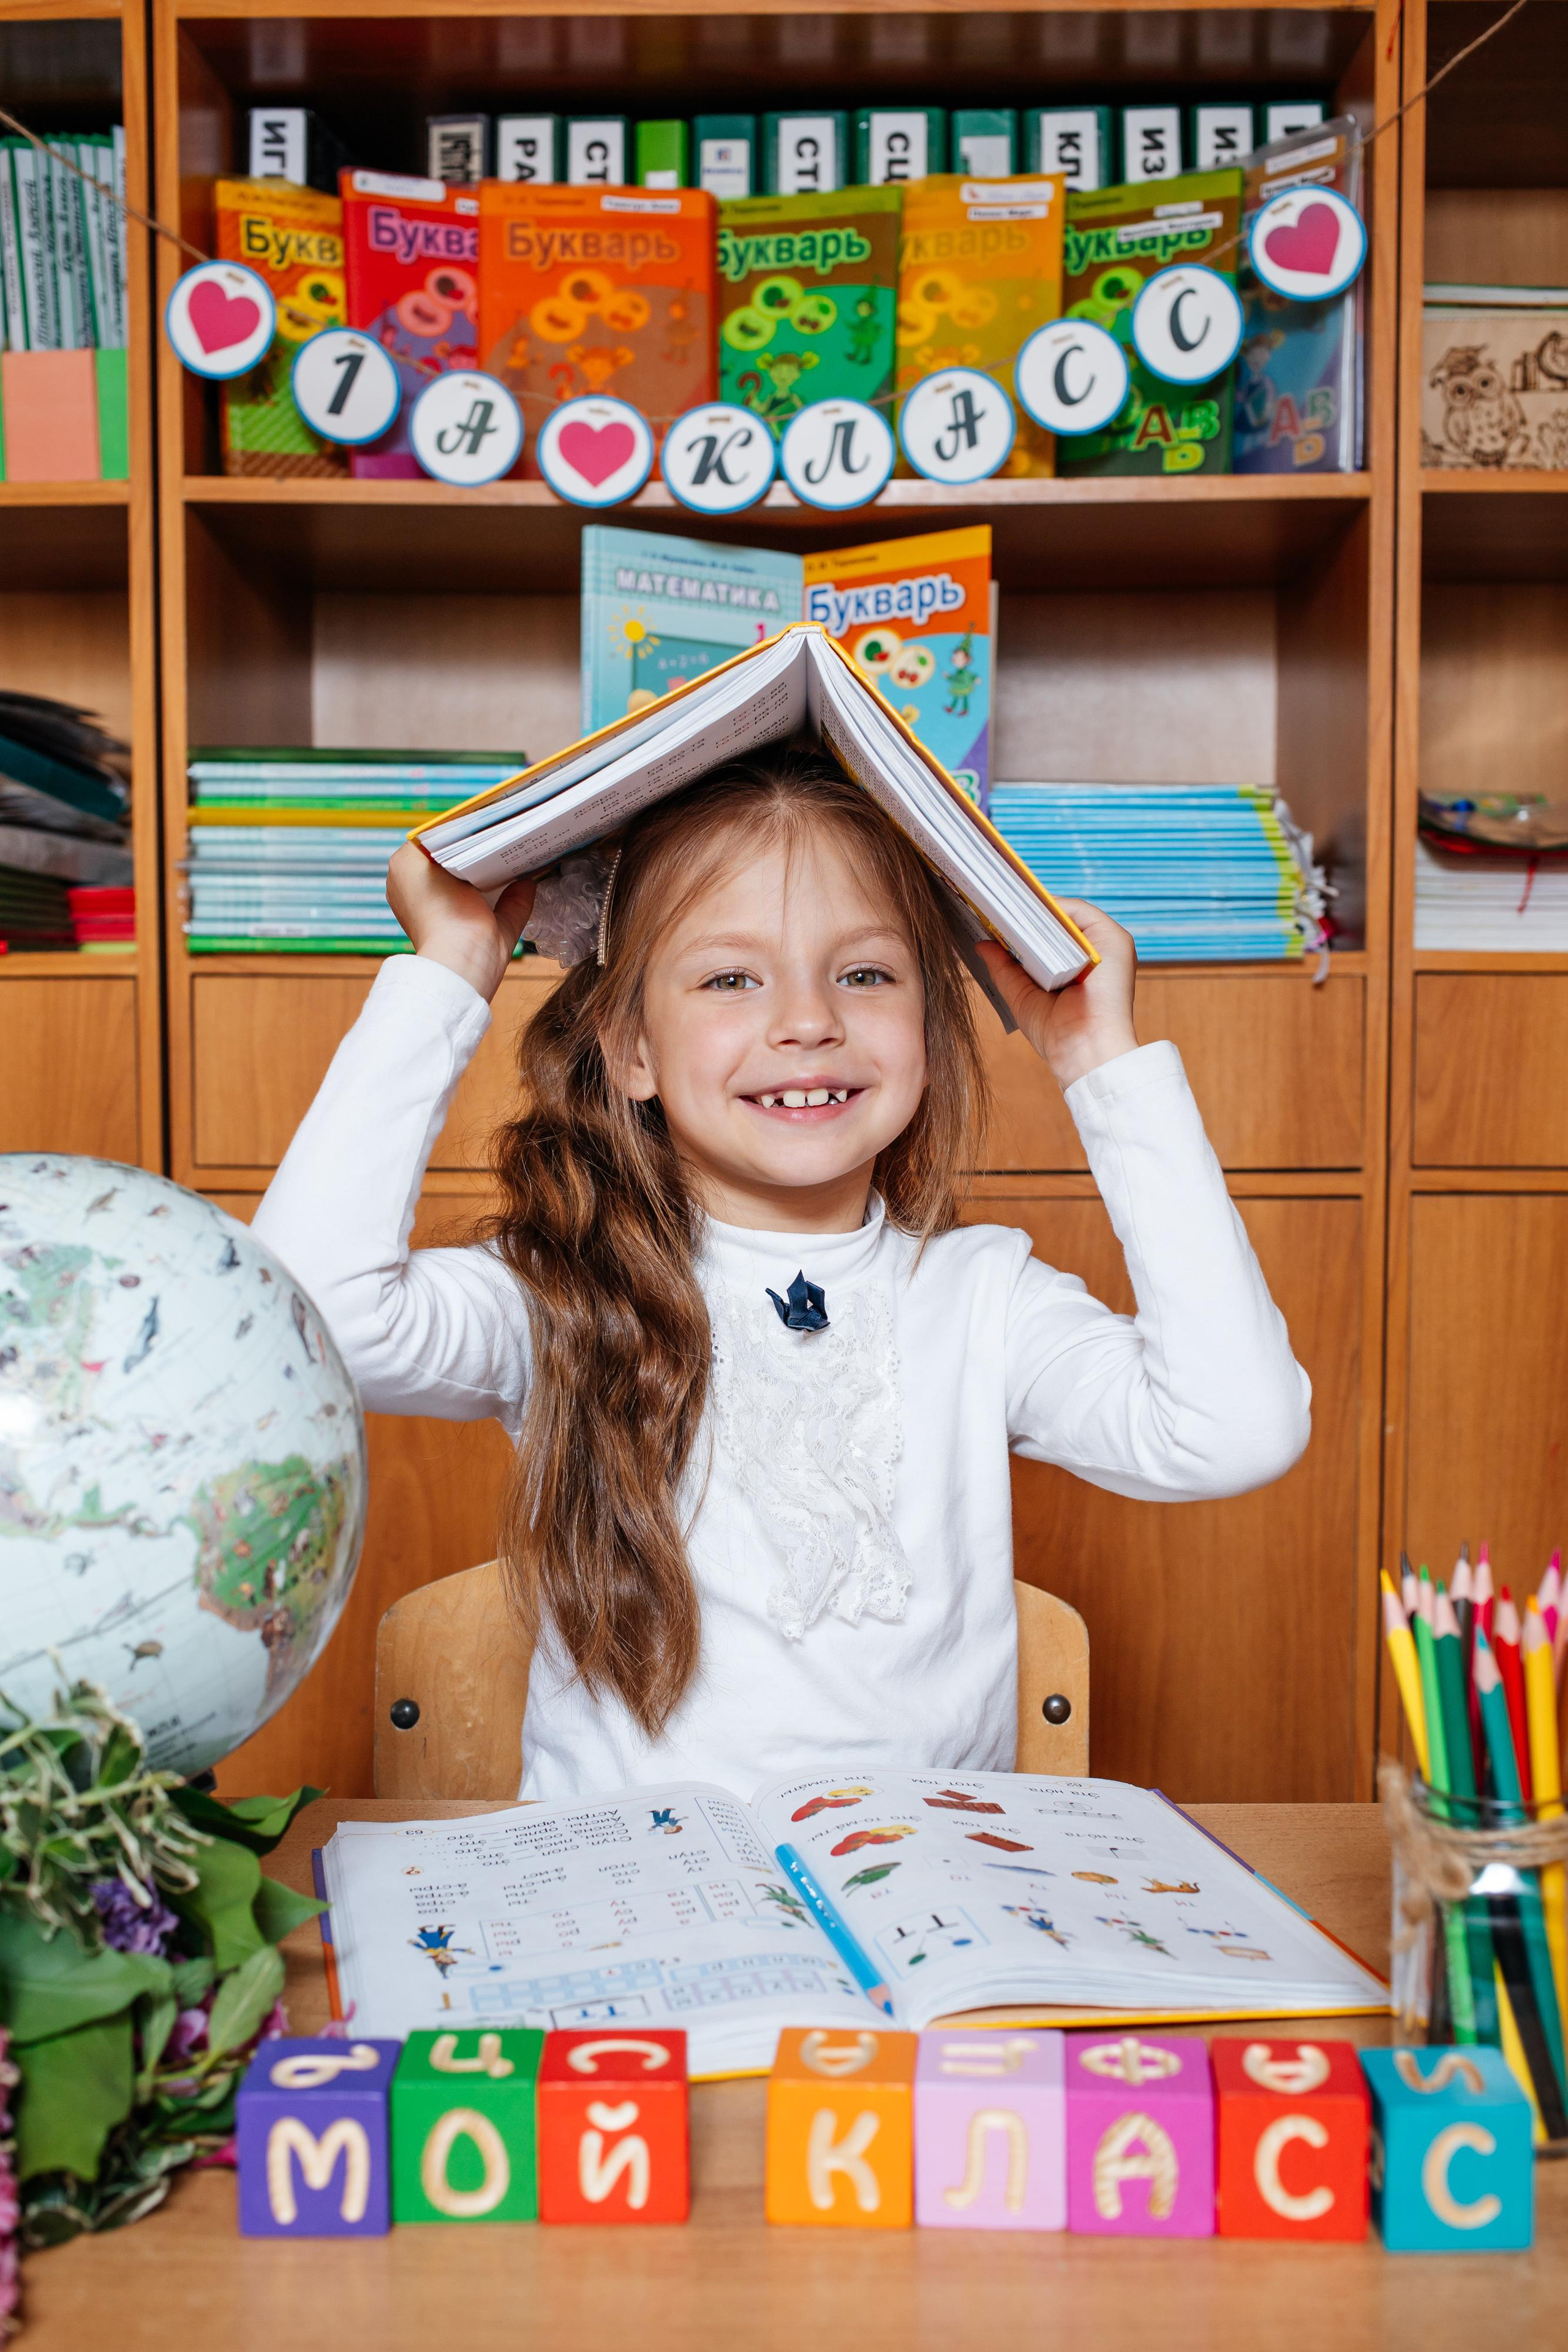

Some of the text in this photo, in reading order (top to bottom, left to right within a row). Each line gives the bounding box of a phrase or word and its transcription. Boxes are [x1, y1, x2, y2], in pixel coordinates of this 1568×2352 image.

[263, 121, 286, 178] ИГ
[796, 137, 819, 194] СТ
[505, 221, 680, 268] Букварь
[327, 353, 499, 456] 1 А
[616, 567, 781, 613] МАТЕМАТИКА
[809, 577, 962, 633] Букварь
